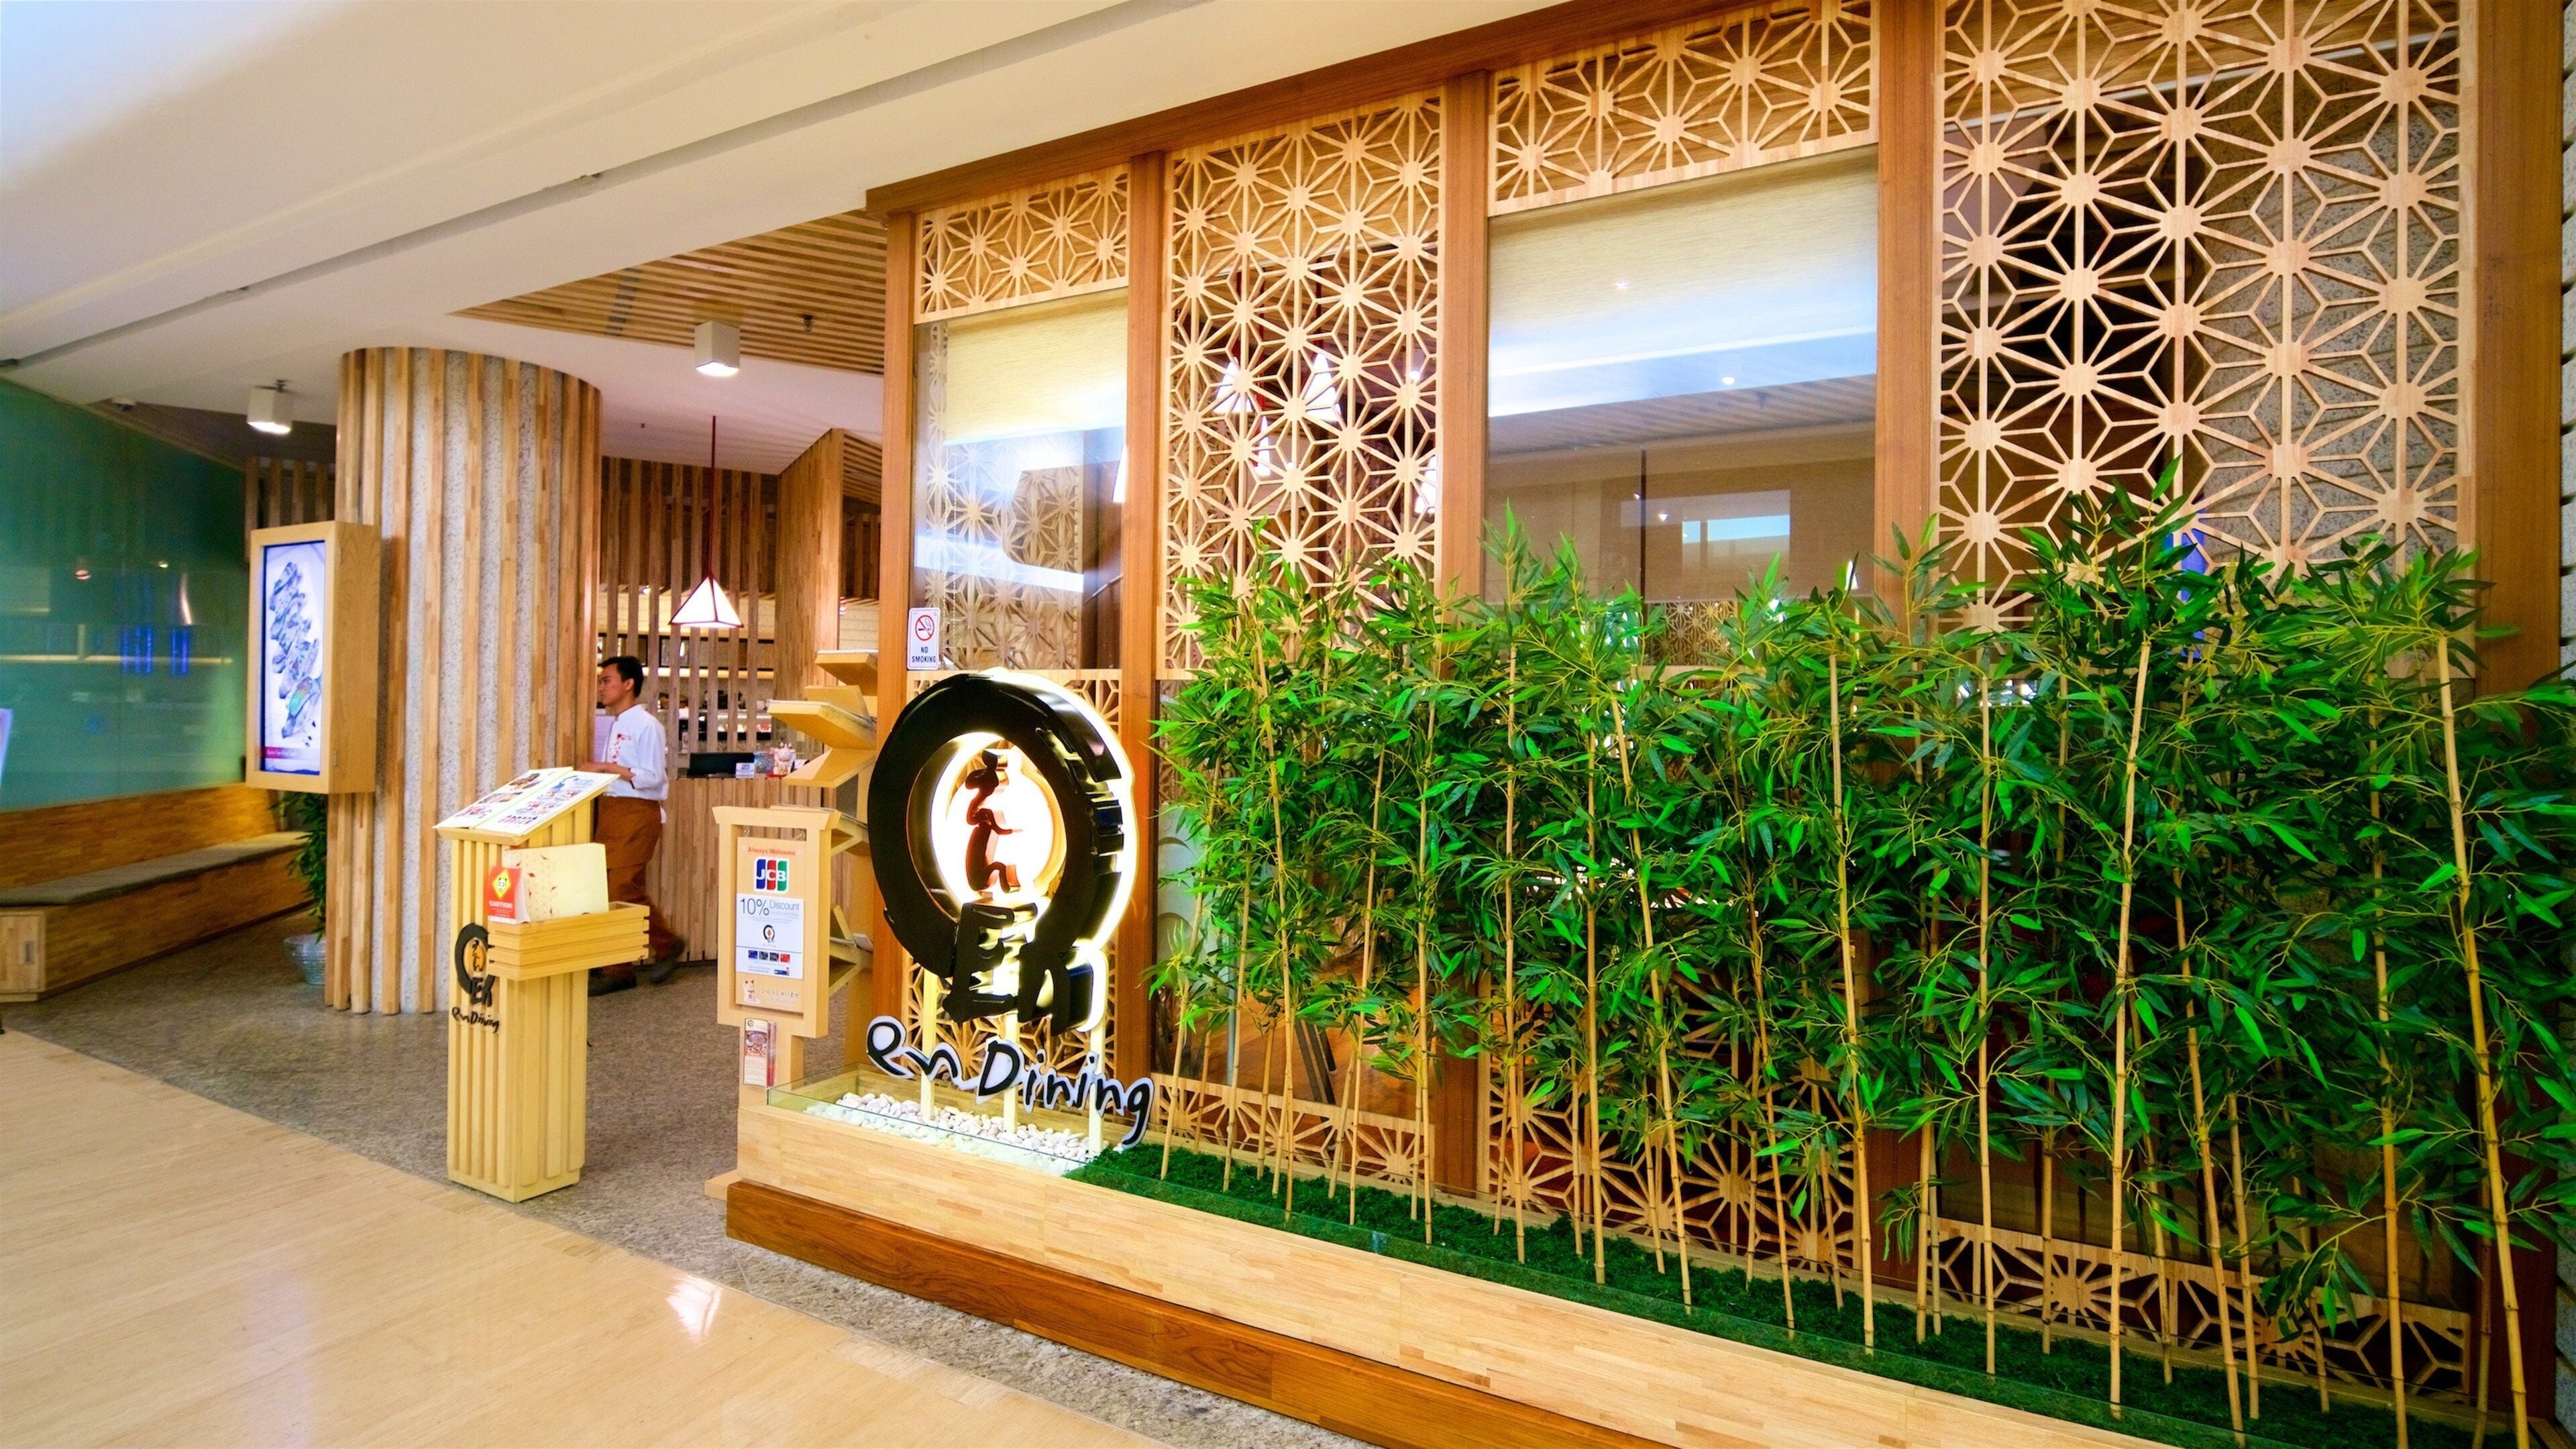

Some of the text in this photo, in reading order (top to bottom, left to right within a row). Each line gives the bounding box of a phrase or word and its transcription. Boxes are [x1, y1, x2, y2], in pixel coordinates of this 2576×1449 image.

[747, 847, 768, 855] Always
[740, 898, 800, 916] 10% Discount
[470, 1010, 500, 1034] Dining
[976, 1038, 1154, 1148] Dining
